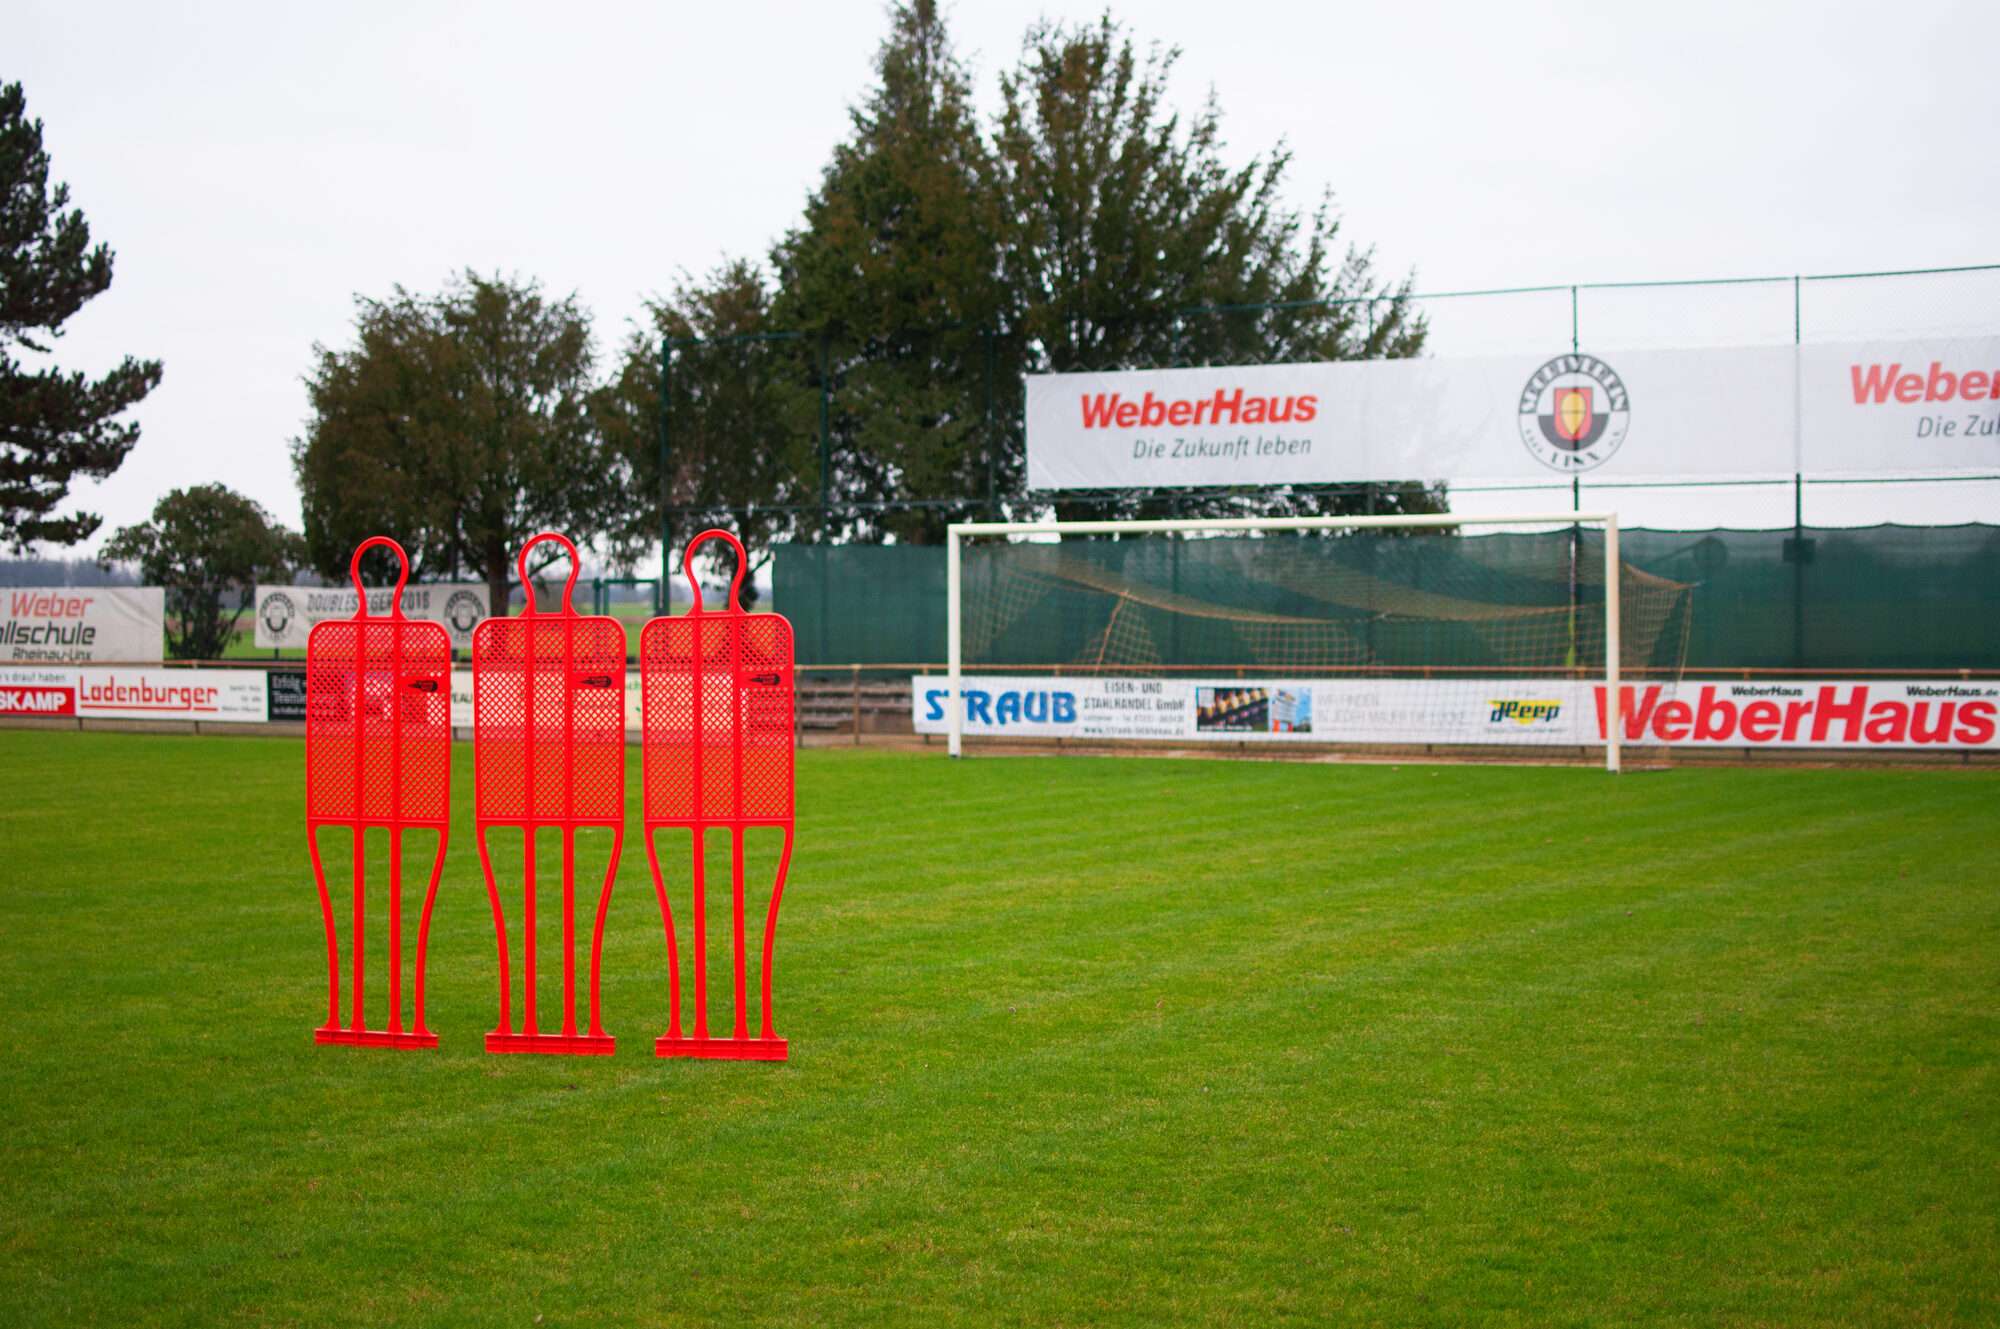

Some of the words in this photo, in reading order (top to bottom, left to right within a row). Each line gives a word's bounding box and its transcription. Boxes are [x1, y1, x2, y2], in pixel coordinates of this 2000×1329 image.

[1081, 388, 1318, 428] WeberHaus
[1917, 416, 1956, 438] Die
[1133, 438, 1165, 459] Die
[1171, 435, 1249, 460] Zukunft
[1256, 436, 1311, 456] leben
[11, 592, 94, 617] Weber
[80, 676, 218, 710] Ladenburger
[1142, 683, 1162, 695] UND
[1731, 686, 1803, 697] WeberHaus
[1906, 685, 1998, 698] WeberHaus.de
[1594, 686, 1998, 744] WeberHaus
